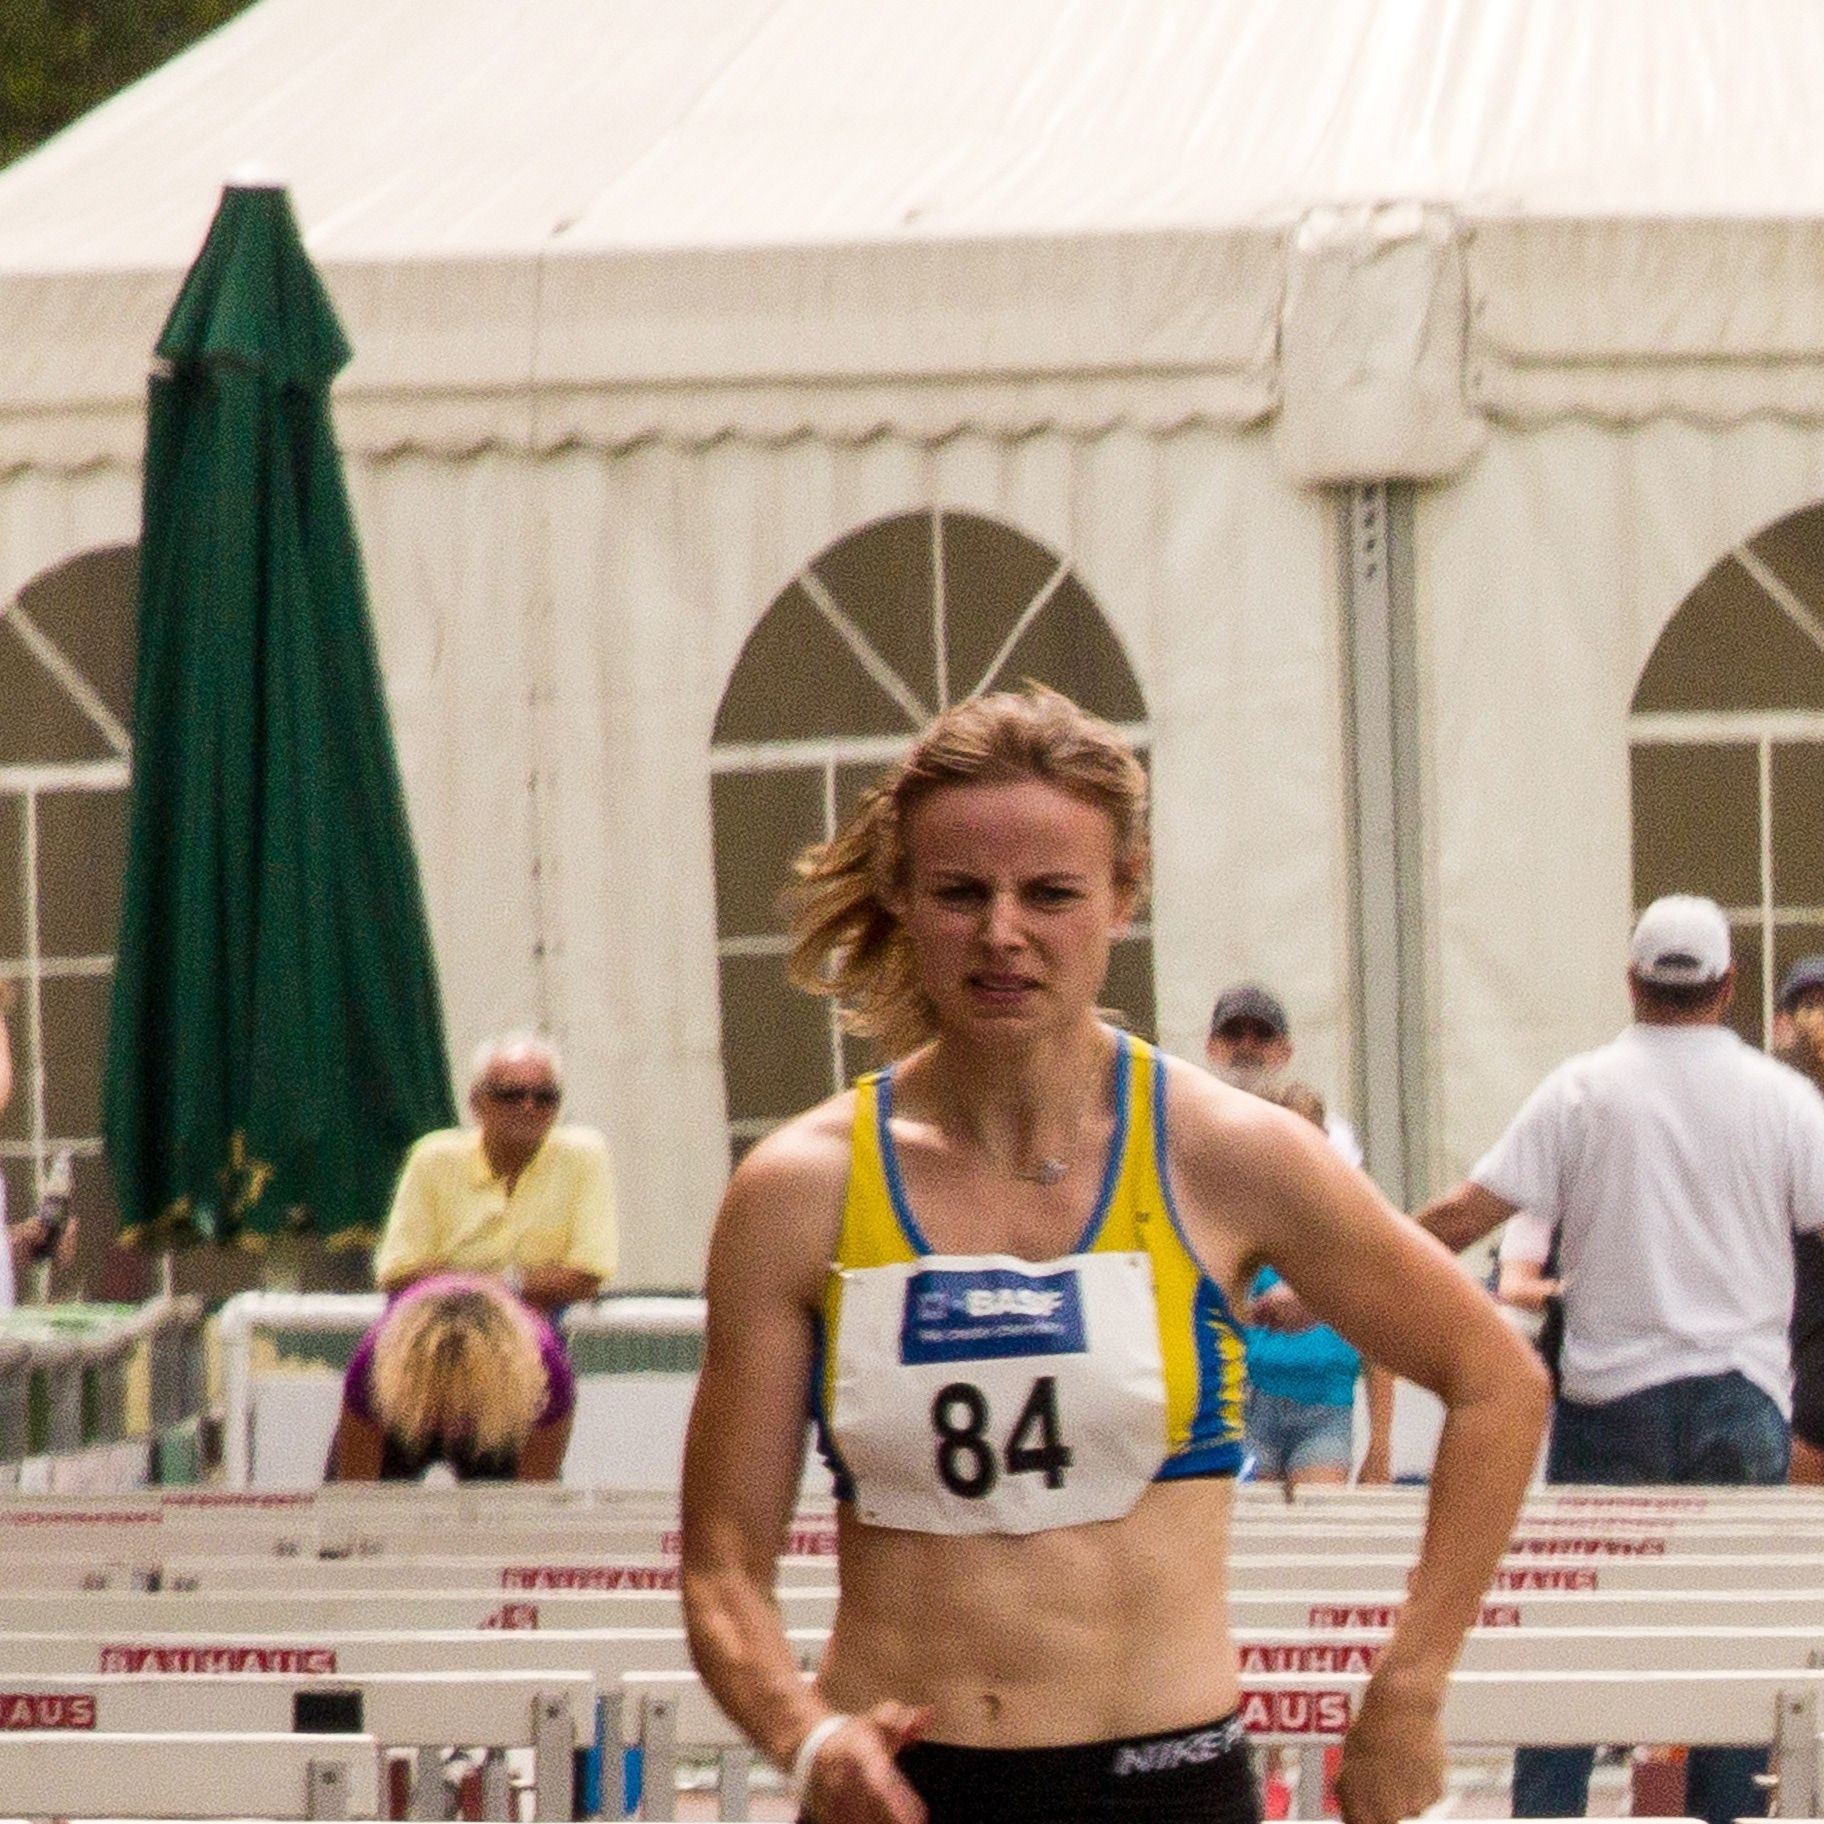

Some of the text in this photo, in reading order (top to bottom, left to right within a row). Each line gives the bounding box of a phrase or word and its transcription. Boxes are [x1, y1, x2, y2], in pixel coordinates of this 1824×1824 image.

[931, 1376, 1075, 1499] 84
[4, 1697, 95, 1727] AUS
[1242, 1695, 1347, 1730] AUS
